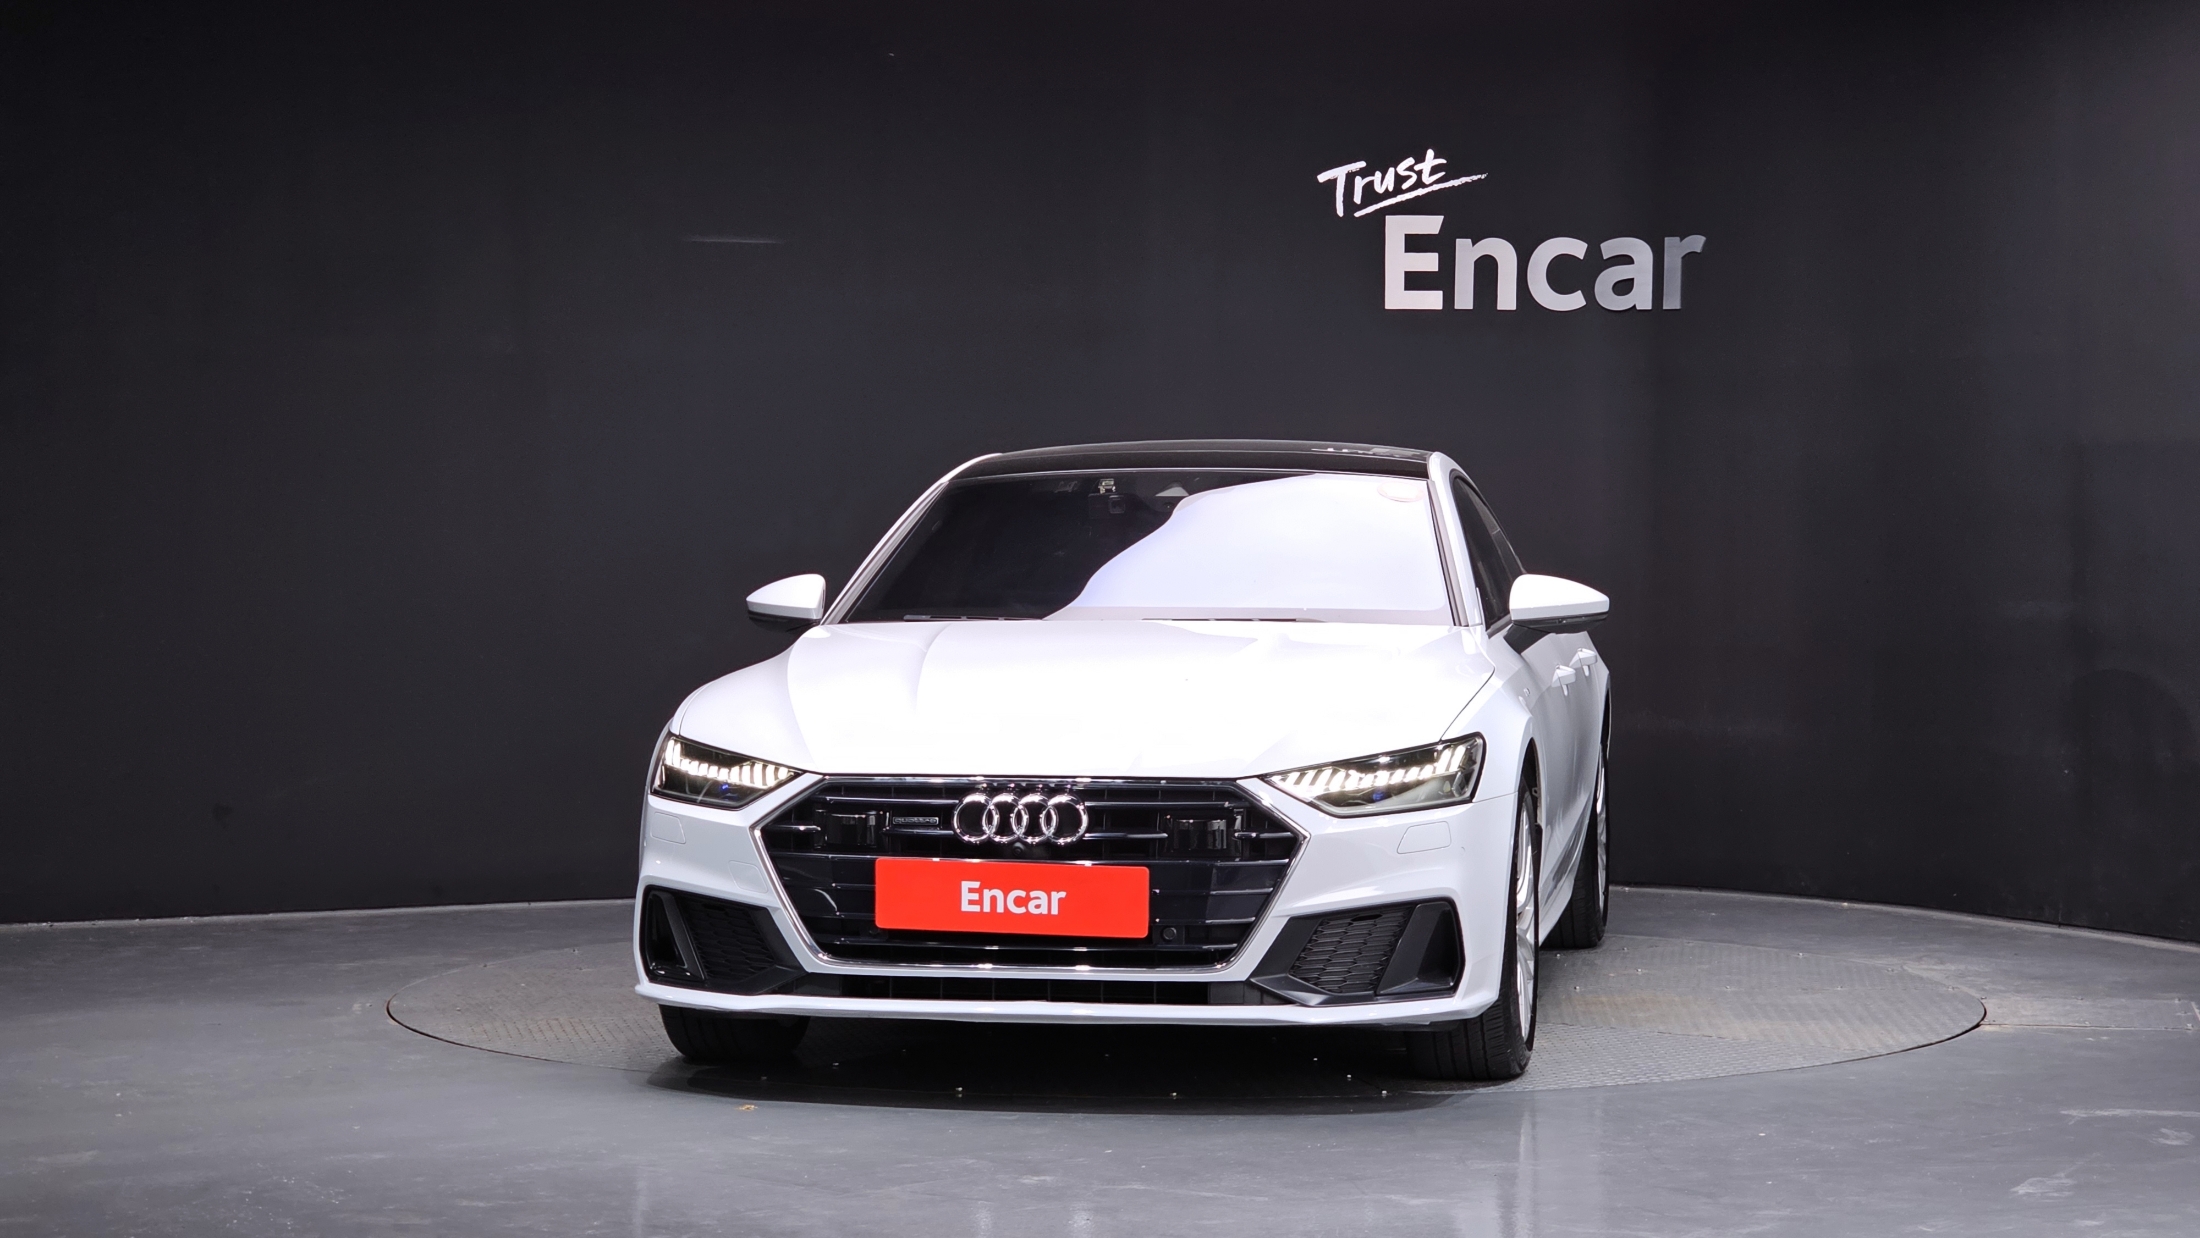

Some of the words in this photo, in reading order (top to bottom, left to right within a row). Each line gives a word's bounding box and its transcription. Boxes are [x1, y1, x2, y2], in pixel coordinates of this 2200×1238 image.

[1317, 149, 1448, 217] Trust
[1385, 215, 1706, 311] Encar
[961, 881, 1067, 915] Encar
